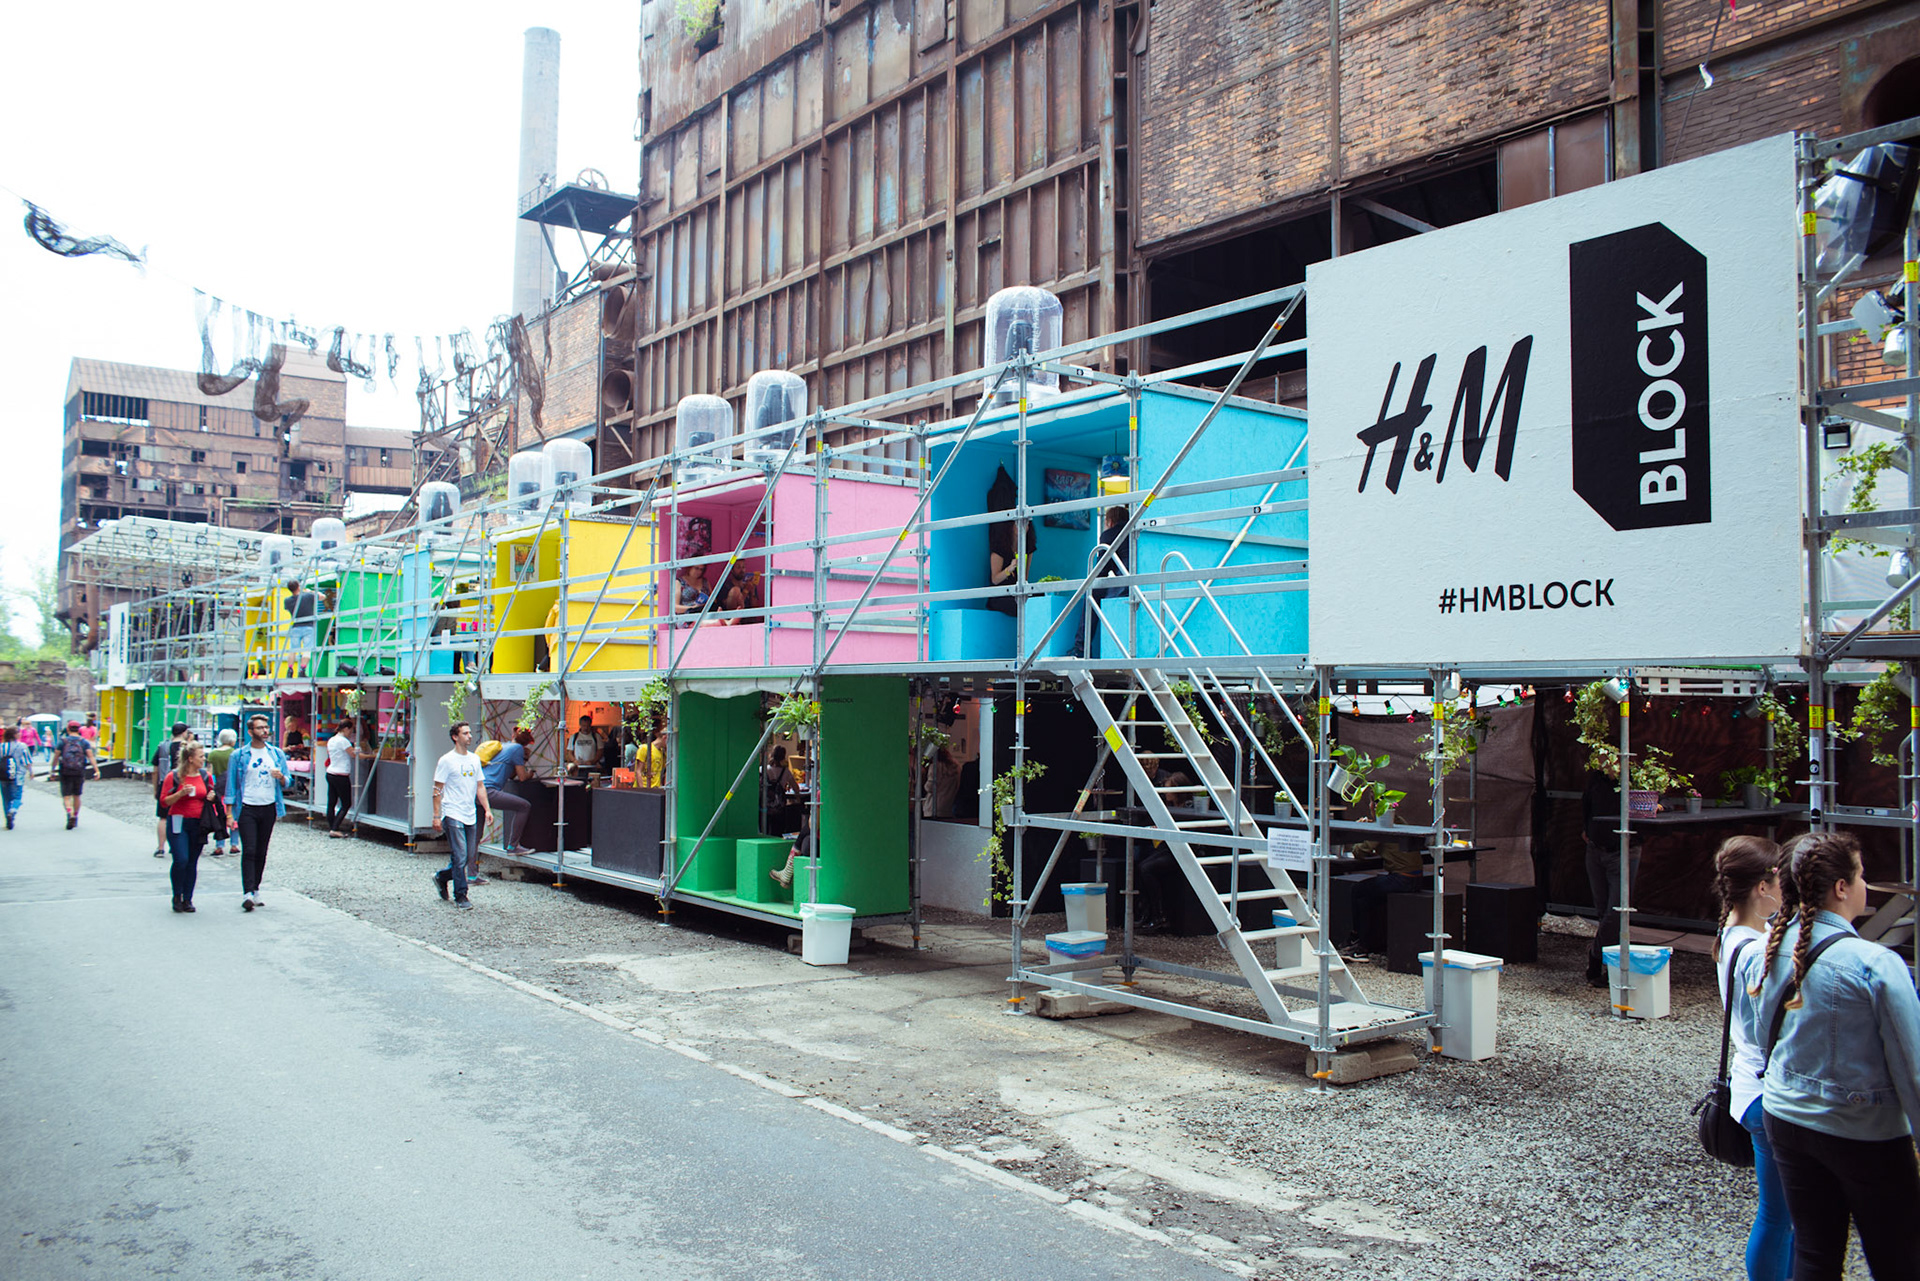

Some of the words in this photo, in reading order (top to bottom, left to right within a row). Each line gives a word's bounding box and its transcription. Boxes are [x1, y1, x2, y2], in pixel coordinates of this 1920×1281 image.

[1356, 334, 1534, 495] H&M
[1636, 281, 1687, 506] BLOCK
[1438, 577, 1615, 614] #HMBLOCK
